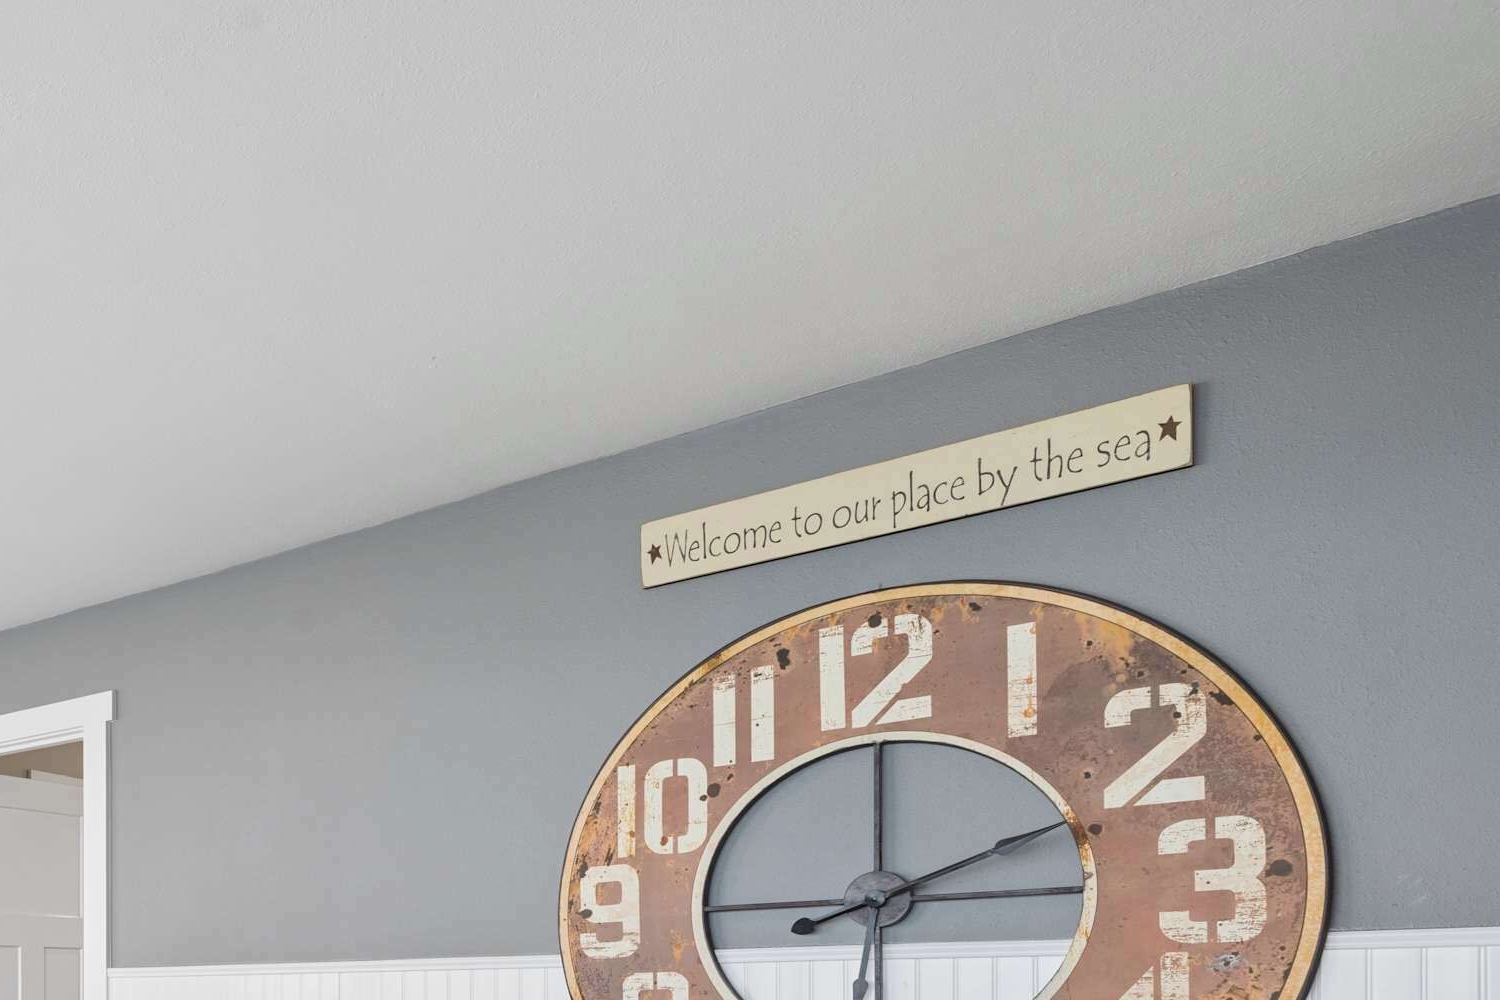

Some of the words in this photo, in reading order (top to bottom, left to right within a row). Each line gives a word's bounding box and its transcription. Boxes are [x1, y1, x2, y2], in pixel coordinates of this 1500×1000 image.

[663, 519, 782, 569] Welcome
[792, 505, 822, 539] to
[831, 496, 882, 530] our
[891, 470, 966, 530] place
[976, 456, 1021, 507] by
[1029, 437, 1084, 484] the
[1096, 428, 1153, 468] sea
[712, 664, 775, 768] 11
[819, 612, 933, 732] 12
[1006, 621, 1038, 738] 1
[1102, 681, 1208, 809] 2
[616, 756, 708, 859] 10
[579, 863, 641, 960] 9
[1156, 814, 1266, 945] 3
